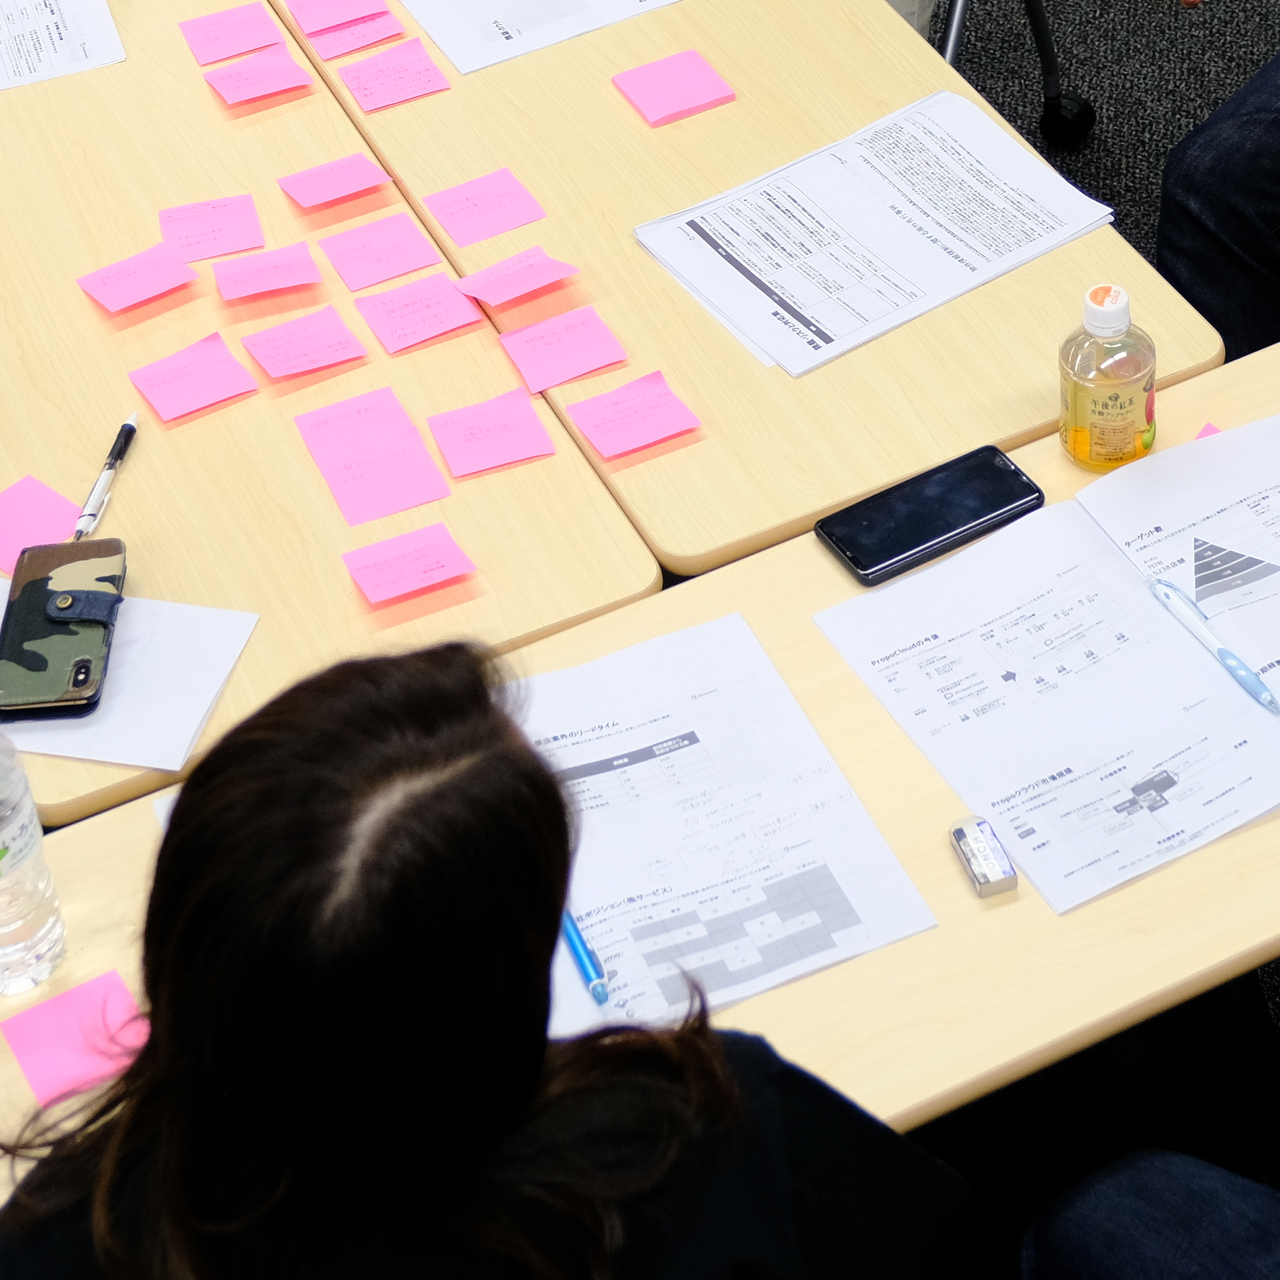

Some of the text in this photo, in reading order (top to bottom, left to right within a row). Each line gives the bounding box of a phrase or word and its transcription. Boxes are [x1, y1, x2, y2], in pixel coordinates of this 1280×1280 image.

[1109, 288, 1121, 305] COLD
[1090, 396, 1135, 410] 午後の紅茶
[1122, 523, 1164, 549] ターゲット数
[869, 631, 940, 668] PropoCloudの今後
[990, 766, 1074, 809] Propoクラウド市場規模
